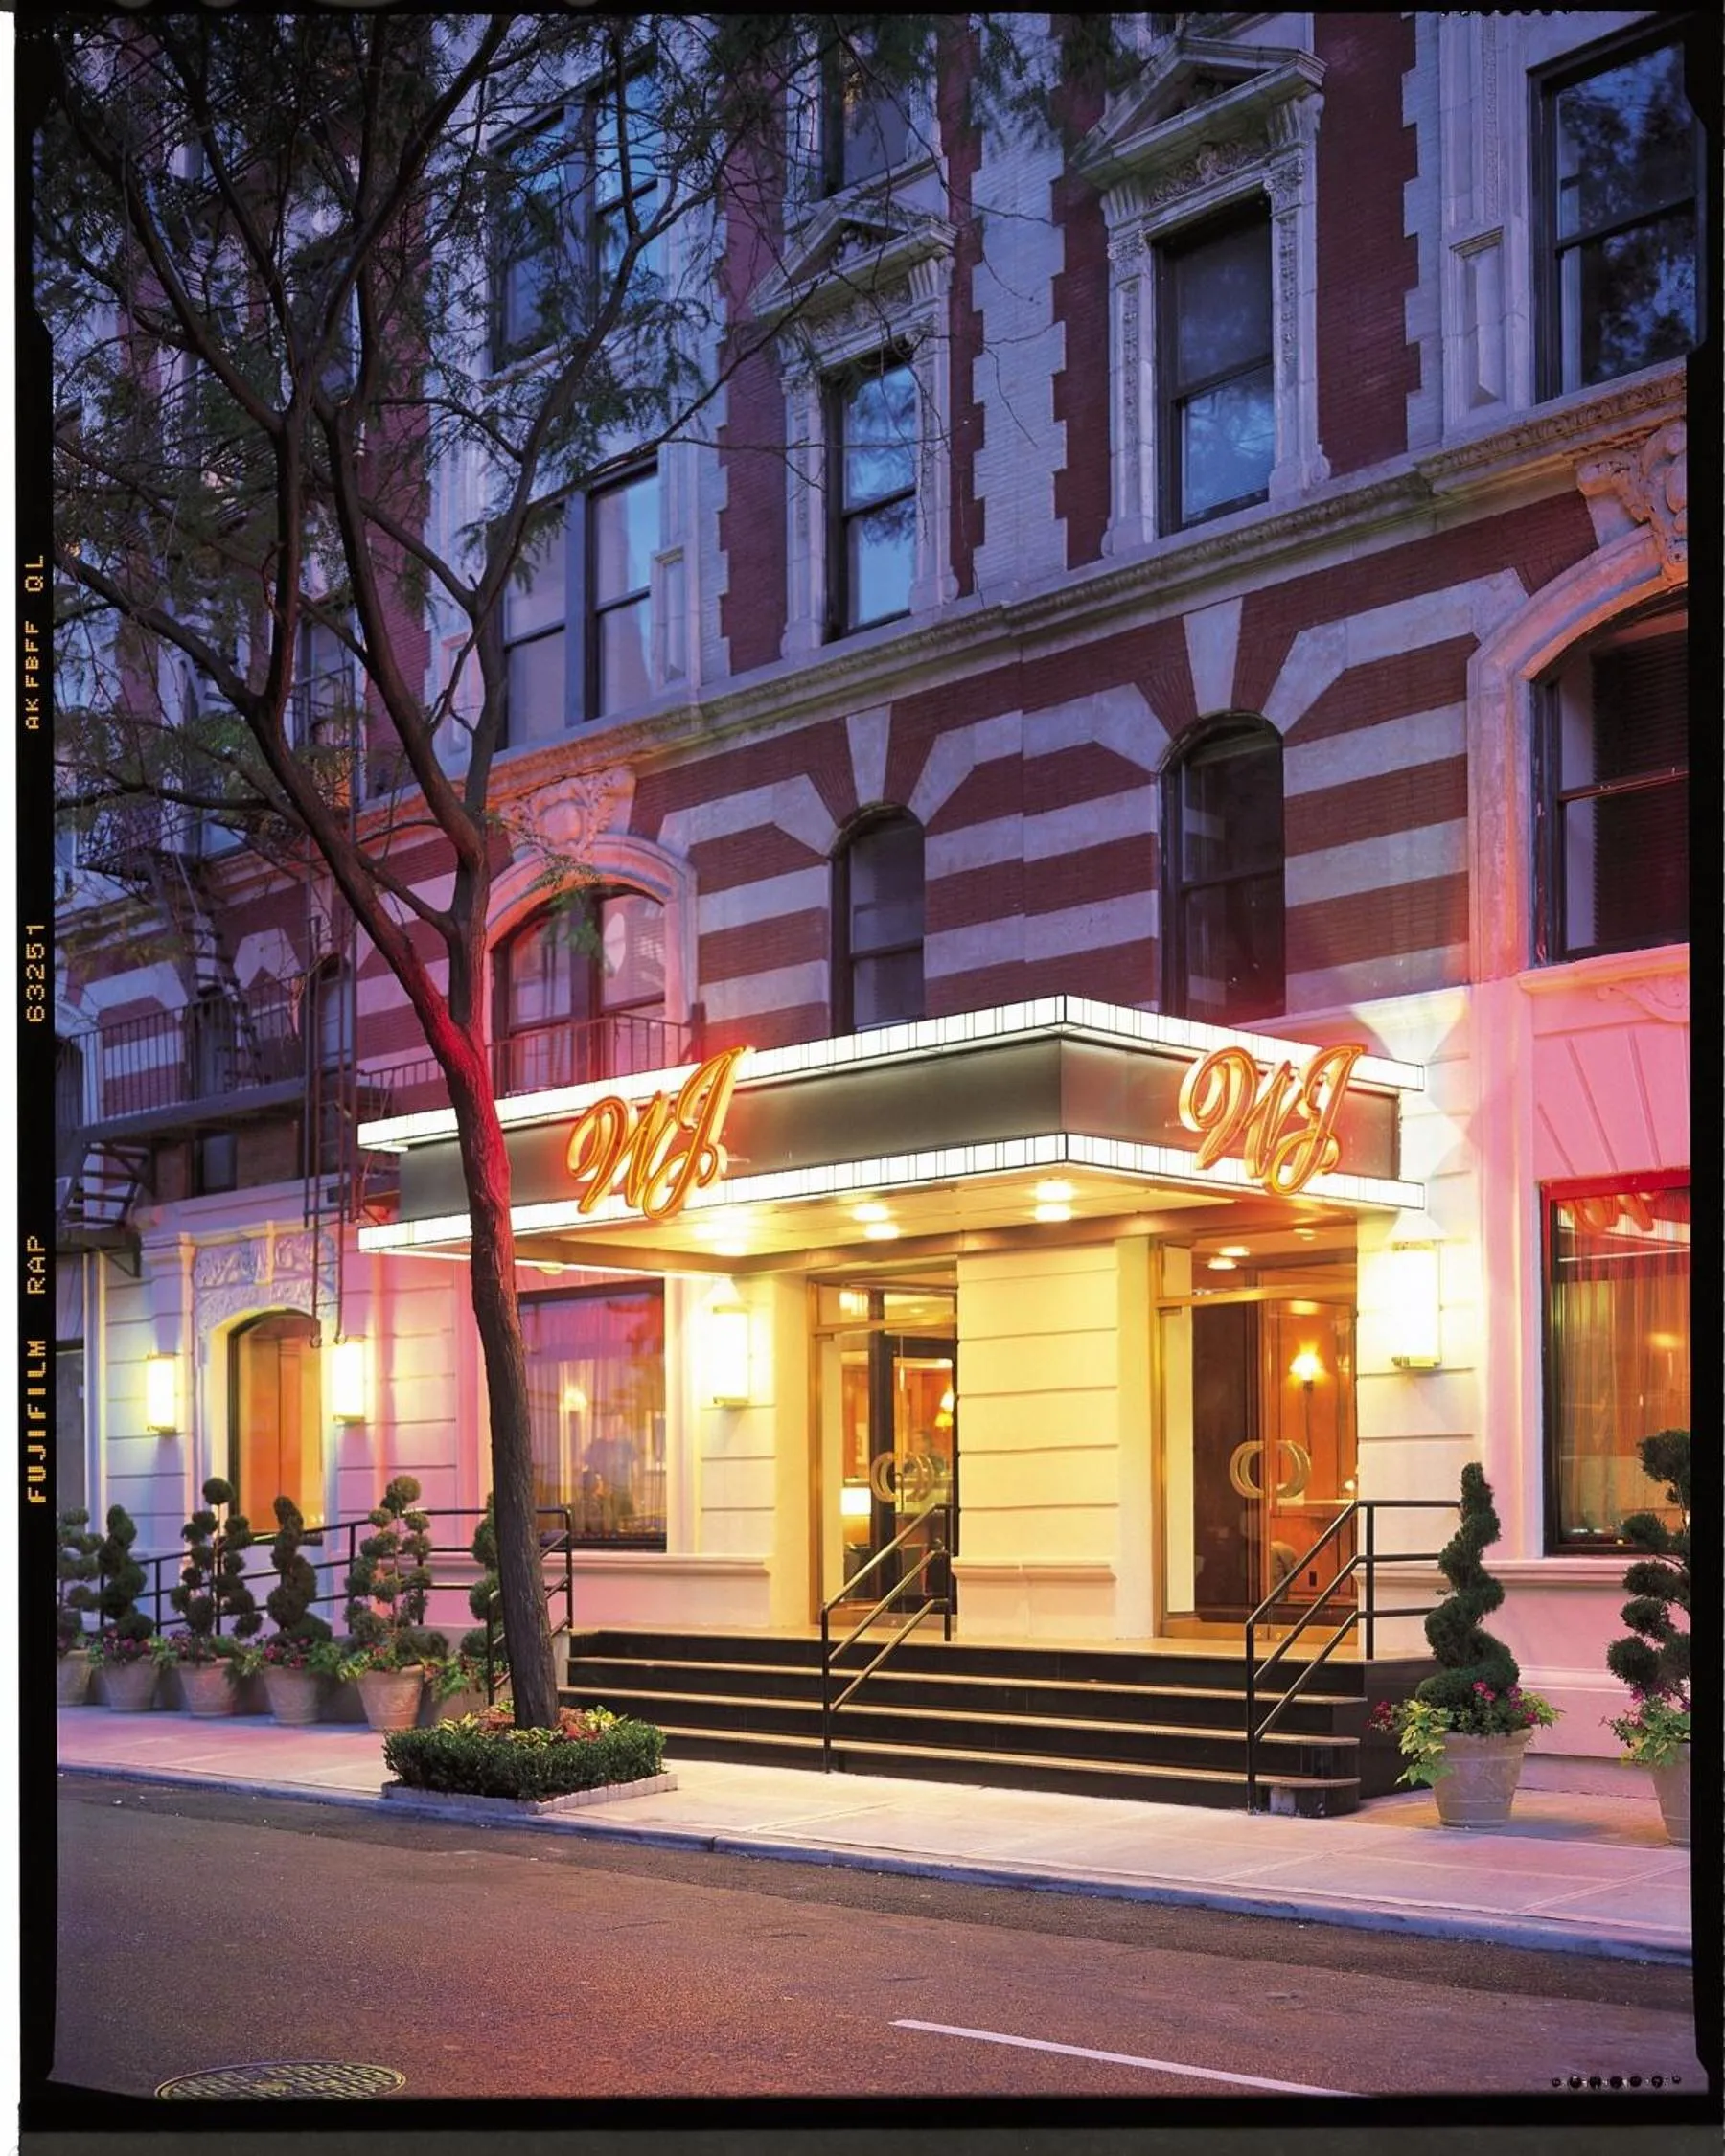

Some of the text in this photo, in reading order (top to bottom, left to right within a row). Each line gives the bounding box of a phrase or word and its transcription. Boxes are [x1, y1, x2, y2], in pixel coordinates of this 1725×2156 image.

[24, 554, 44, 593] QL
[25, 924, 46, 1023] 63251
[26, 1235, 47, 1504] FUJIFILM RAP
